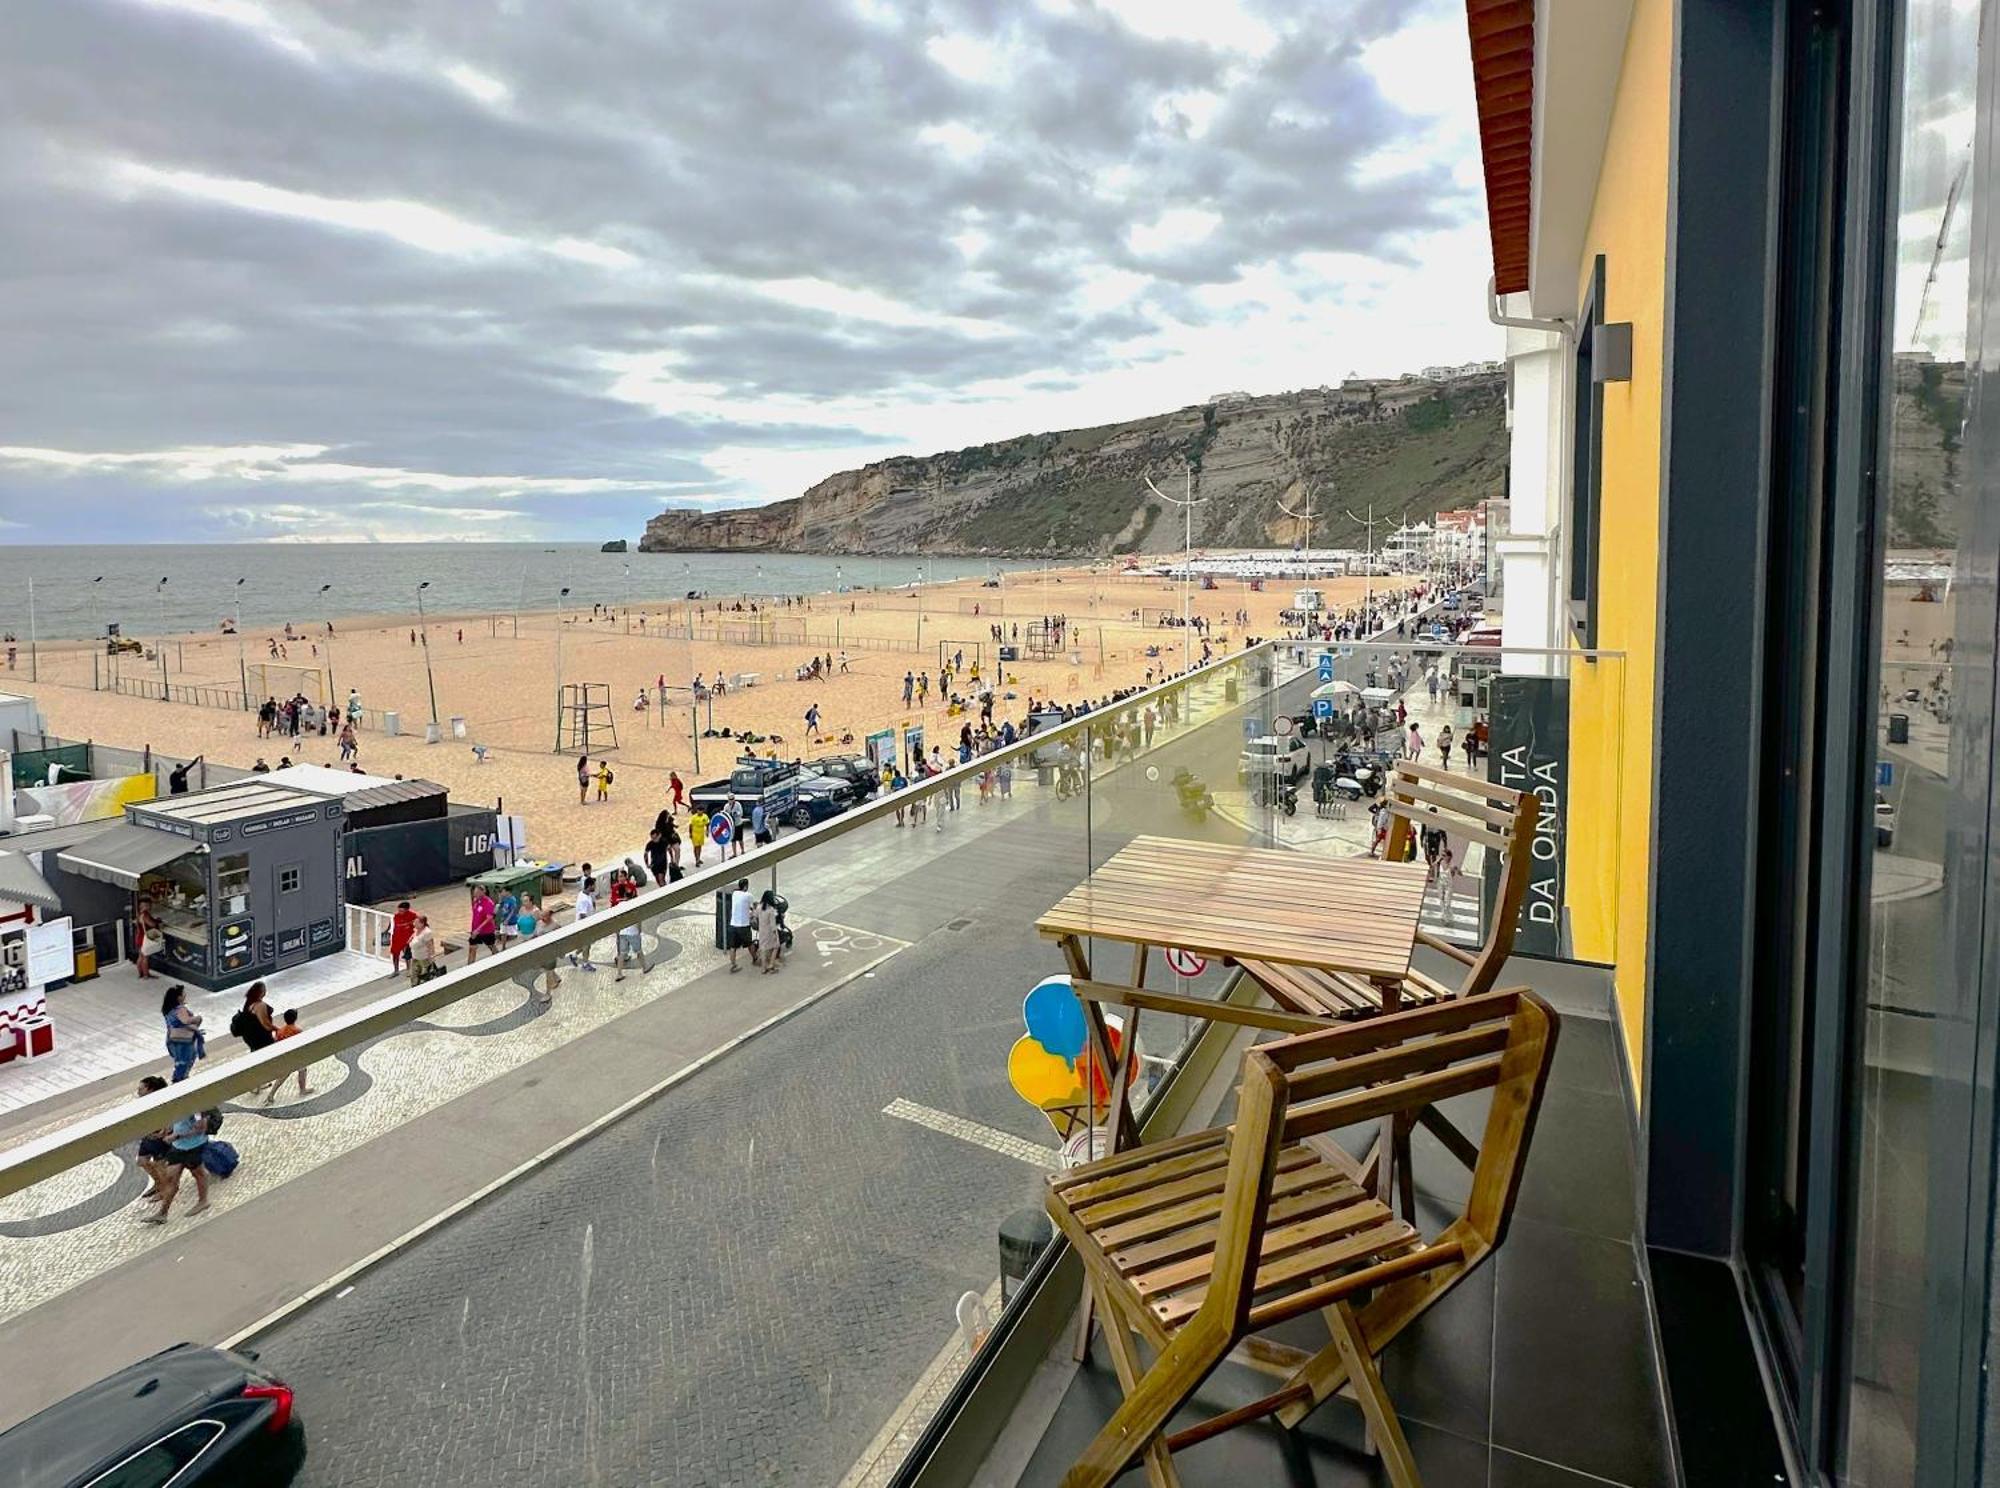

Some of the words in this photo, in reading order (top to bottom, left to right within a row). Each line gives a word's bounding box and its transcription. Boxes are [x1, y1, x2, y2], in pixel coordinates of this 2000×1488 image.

[1317, 701, 1329, 716] P
[1531, 761, 1559, 861] ONDA
[465, 833, 497, 856] LIGA
[1530, 878, 1556, 925] DA
